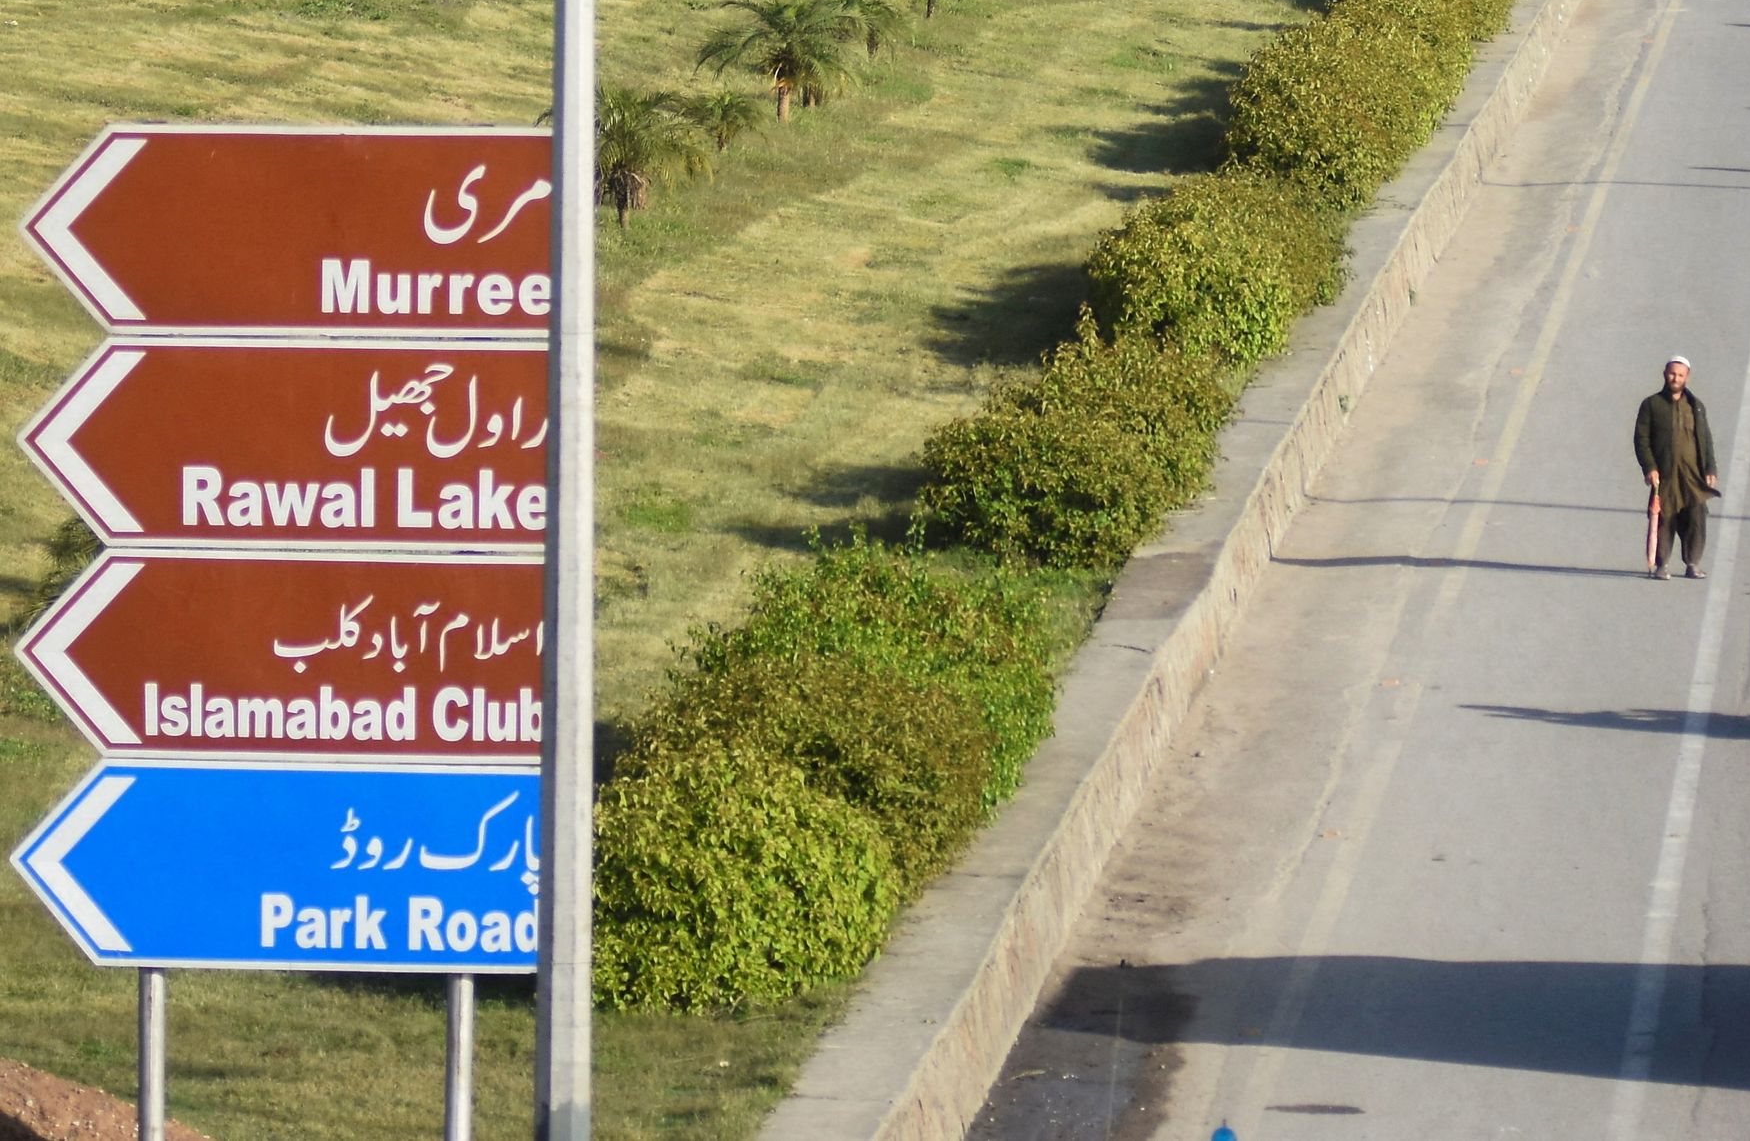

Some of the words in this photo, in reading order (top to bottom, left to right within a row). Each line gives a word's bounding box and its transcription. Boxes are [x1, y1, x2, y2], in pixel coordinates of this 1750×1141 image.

[423, 165, 553, 245] مری
[321, 259, 552, 316] Murree
[324, 363, 455, 457] جھیل
[426, 374, 549, 459] راول
[182, 465, 375, 527] Rawal
[397, 467, 547, 531] Lake
[273, 594, 374, 674] کلب
[362, 601, 441, 673] آباد
[440, 613, 544, 673] اسلام
[145, 683, 416, 742] Islamabad
[432, 686, 542, 743] Club
[331, 807, 413, 871] روڈ
[419, 790, 540, 896] پارک
[261, 893, 386, 950] Park
[408, 897, 539, 953] Road
